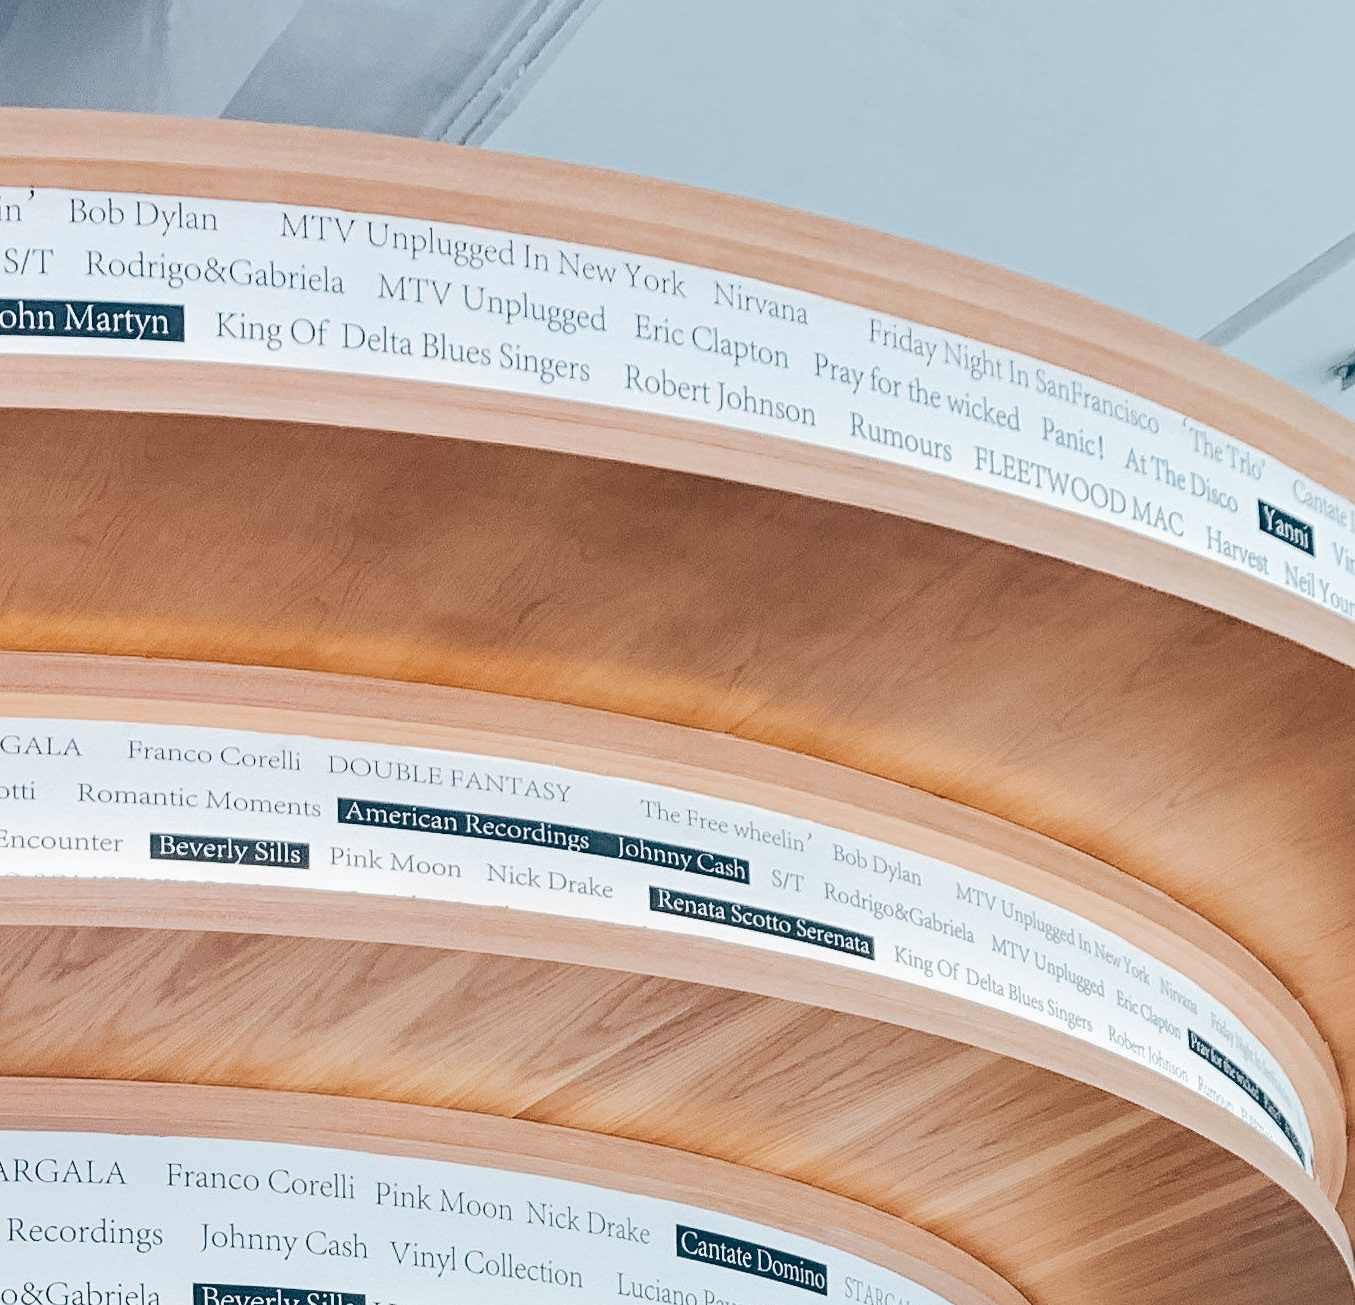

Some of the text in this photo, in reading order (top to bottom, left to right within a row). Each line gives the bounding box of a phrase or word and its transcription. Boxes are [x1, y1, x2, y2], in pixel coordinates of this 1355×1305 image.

[64, 305, 169, 340] Martyn
[869, 318, 1159, 438] Friday Night In SanFrancisco
[974, 442, 1184, 537] FLEETWOOD MAC
[1042, 416, 1238, 513] Panic! At The Disco
[1263, 506, 1309, 550] Yanni
[130, 741, 212, 762] Franco
[221, 748, 300, 770] Corelli
[160, 836, 300, 864] Beverly Sills
[346, 804, 745, 878] American Recordings Johnny Cash
[658, 890, 869, 954] Renata Scotto Serenata
[168, 1163, 259, 1191] Franco
[269, 1169, 354, 1199] Corelli
